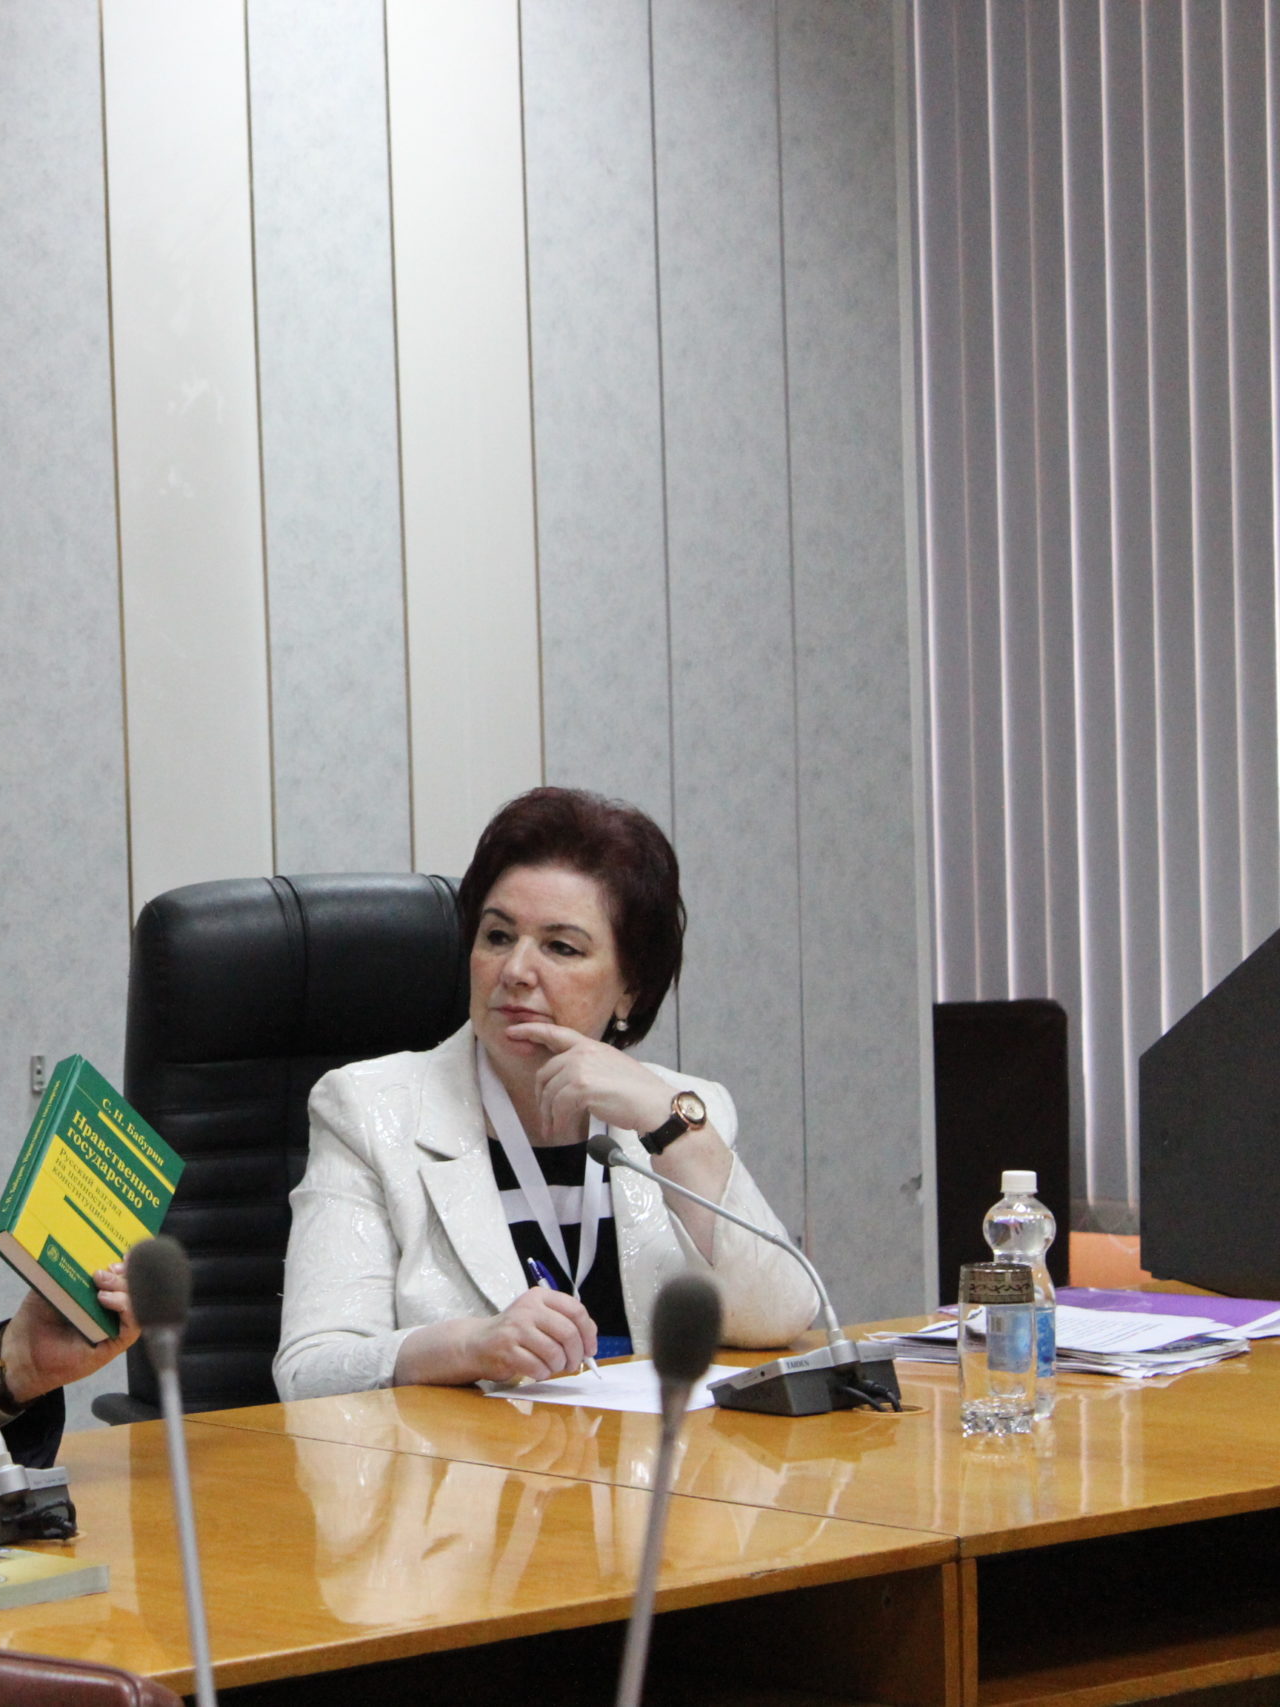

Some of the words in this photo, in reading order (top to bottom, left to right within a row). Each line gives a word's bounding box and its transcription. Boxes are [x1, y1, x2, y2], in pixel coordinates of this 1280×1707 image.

[67, 1127, 143, 1209] государство
[72, 1110, 160, 1208] Нравственное
[102, 1098, 112, 1114] С.
[114, 1109, 125, 1126] Н.
[126, 1123, 165, 1166] Бабурин
[52, 1166, 131, 1249] конституционализ
[55, 1158, 66, 1171] на
[67, 1170, 108, 1213] ценности
[59, 1148, 94, 1186] Русский
[95, 1187, 122, 1217] взгляд
